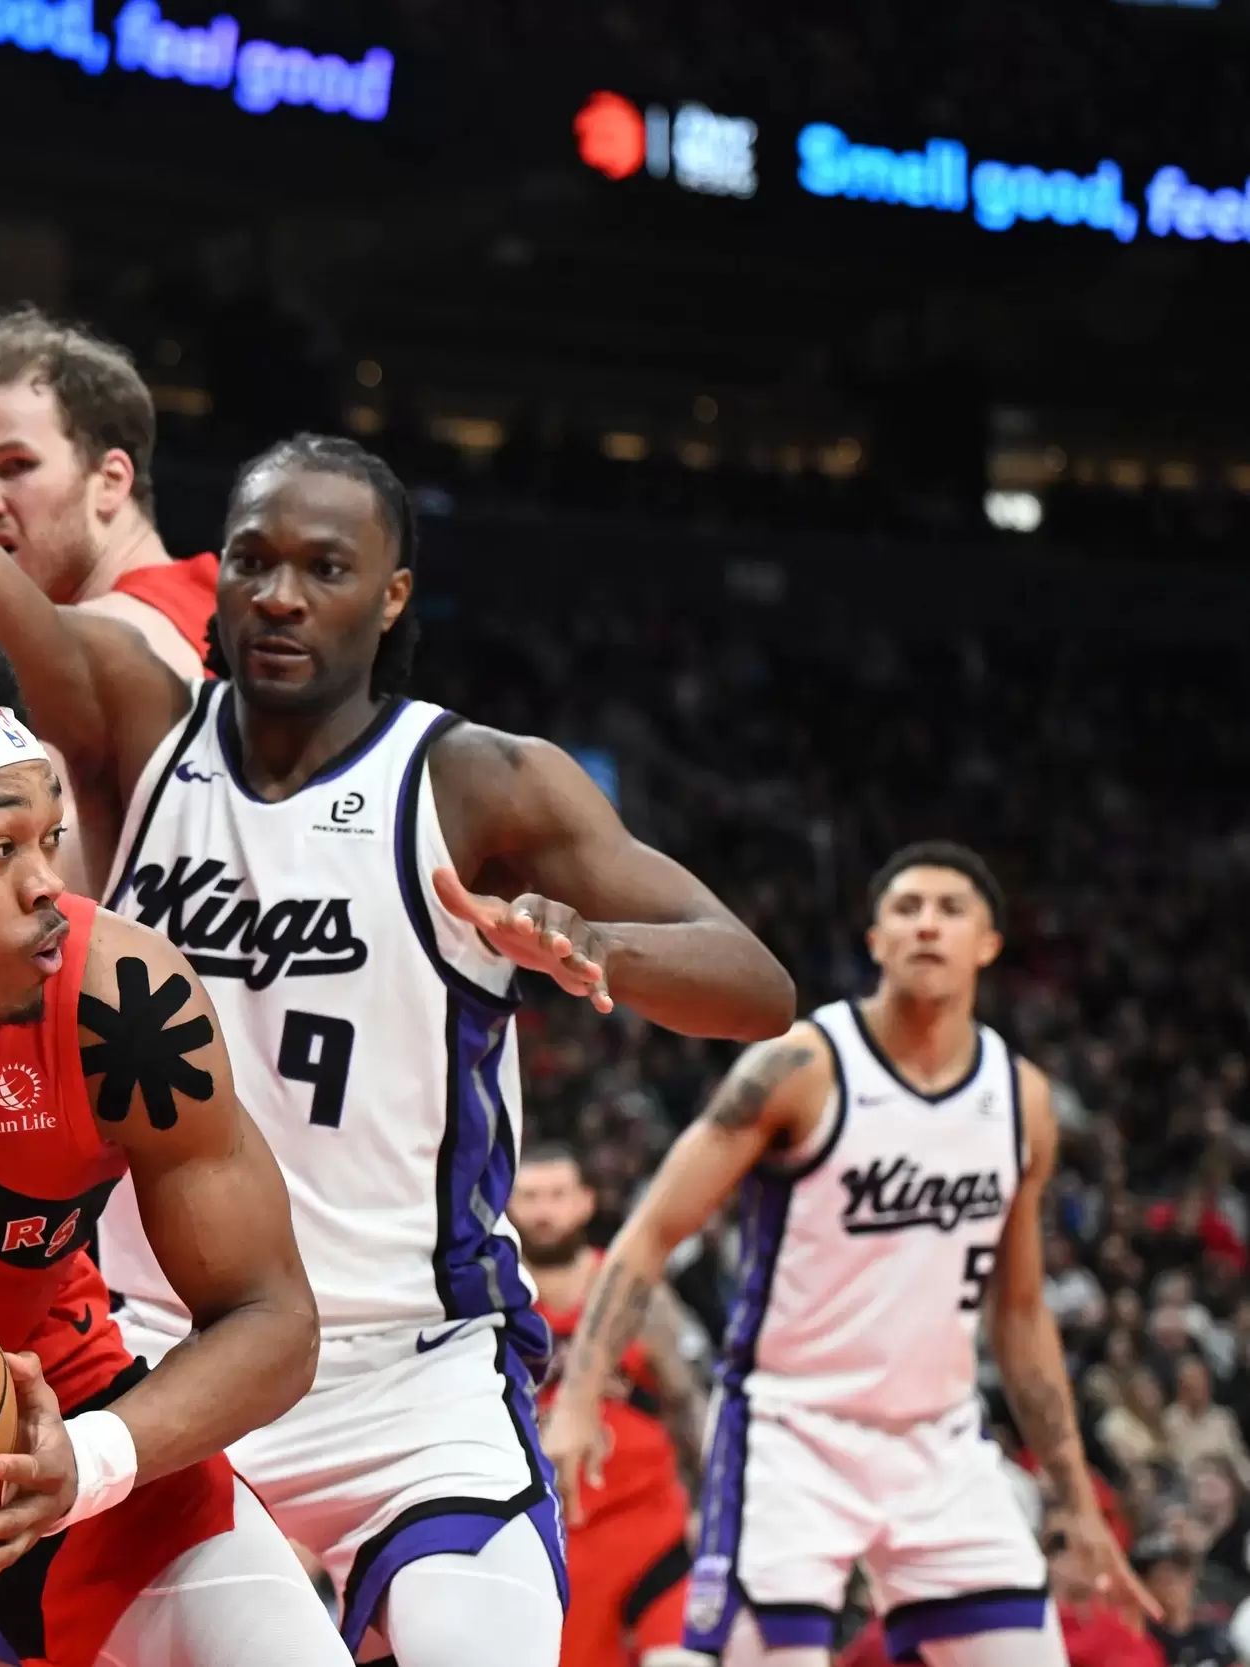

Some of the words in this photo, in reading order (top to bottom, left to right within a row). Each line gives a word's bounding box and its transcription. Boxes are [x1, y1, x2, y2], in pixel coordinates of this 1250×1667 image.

[116, 0, 239, 88] feel
[235, 38, 393, 121] good
[798, 122, 968, 212] Smell
[972, 160, 1138, 243] good,
[1146, 165, 1250, 243] fee
[132, 856, 367, 990] Kings
[22, 1111, 56, 1131] Life
[278, 1010, 355, 1129] 9
[839, 1155, 1003, 1236] Kings
[959, 1244, 999, 1311] 5
